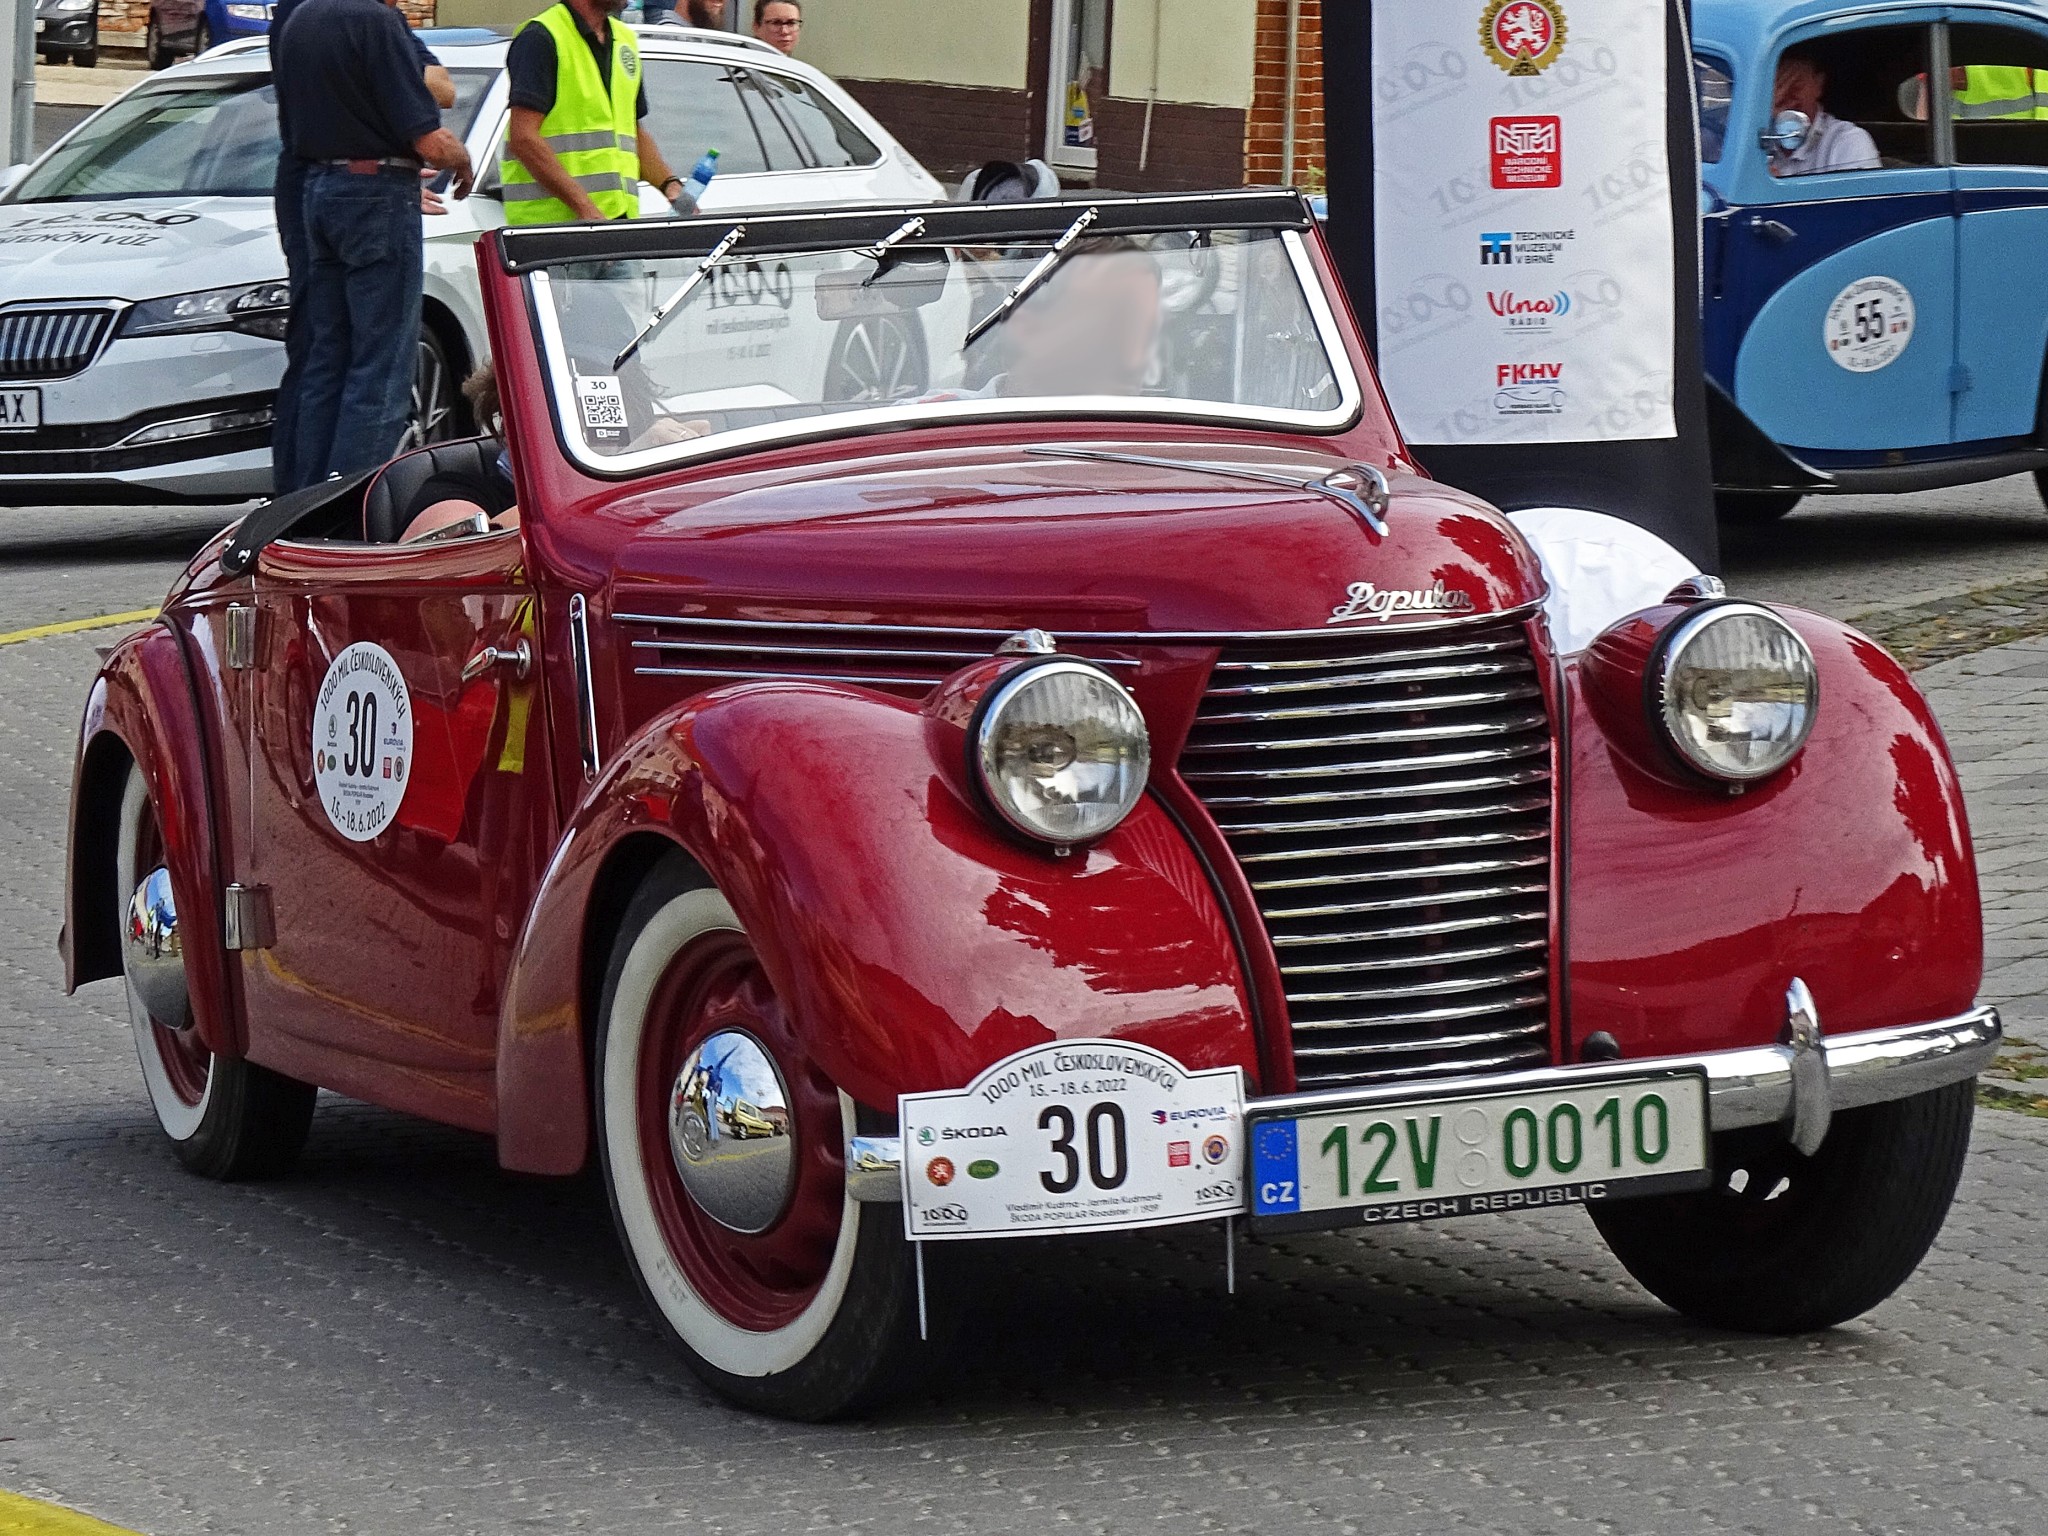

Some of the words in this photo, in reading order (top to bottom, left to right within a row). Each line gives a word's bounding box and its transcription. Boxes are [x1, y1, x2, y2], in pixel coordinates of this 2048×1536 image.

[1495, 123, 1556, 155] NTM
[101, 233, 161, 246] VŮZ
[1515, 228, 1575, 241] TECHNICKÉ
[1515, 243, 1562, 252] MUZEUM
[1515, 256, 1522, 264] V
[1524, 253, 1554, 264] BRNĚ
[1486, 290, 1555, 316] Vlna
[1854, 298, 1886, 342] 55
[591, 381, 607, 390] 30
[1496, 363, 1563, 386] FKHV
[1326, 579, 1476, 623] Popular
[320, 671, 338, 711] 1000
[337, 659, 351, 682] MIL
[350, 648, 406, 719] ČESKOSLOVENSKÝCH
[344, 691, 378, 778] 30
[981, 1072, 1020, 1104] 1000
[1022, 1060, 1052, 1082] MIL
[1053, 1051, 1179, 1093] ČESKOSLOVENSKÝCH
[1169, 1106, 1227, 1121] EUROVIA
[941, 1126, 1008, 1140] ŠKODA
[1321, 1115, 1442, 1198] 12V
[1502, 1092, 1670, 1179] 0010
[1037, 1101, 1129, 1194] 30
[1260, 1179, 1295, 1205] CZ
[1362, 1198, 1460, 1223] CZECH
[1470, 1183, 1608, 1211] REPUBLIC
